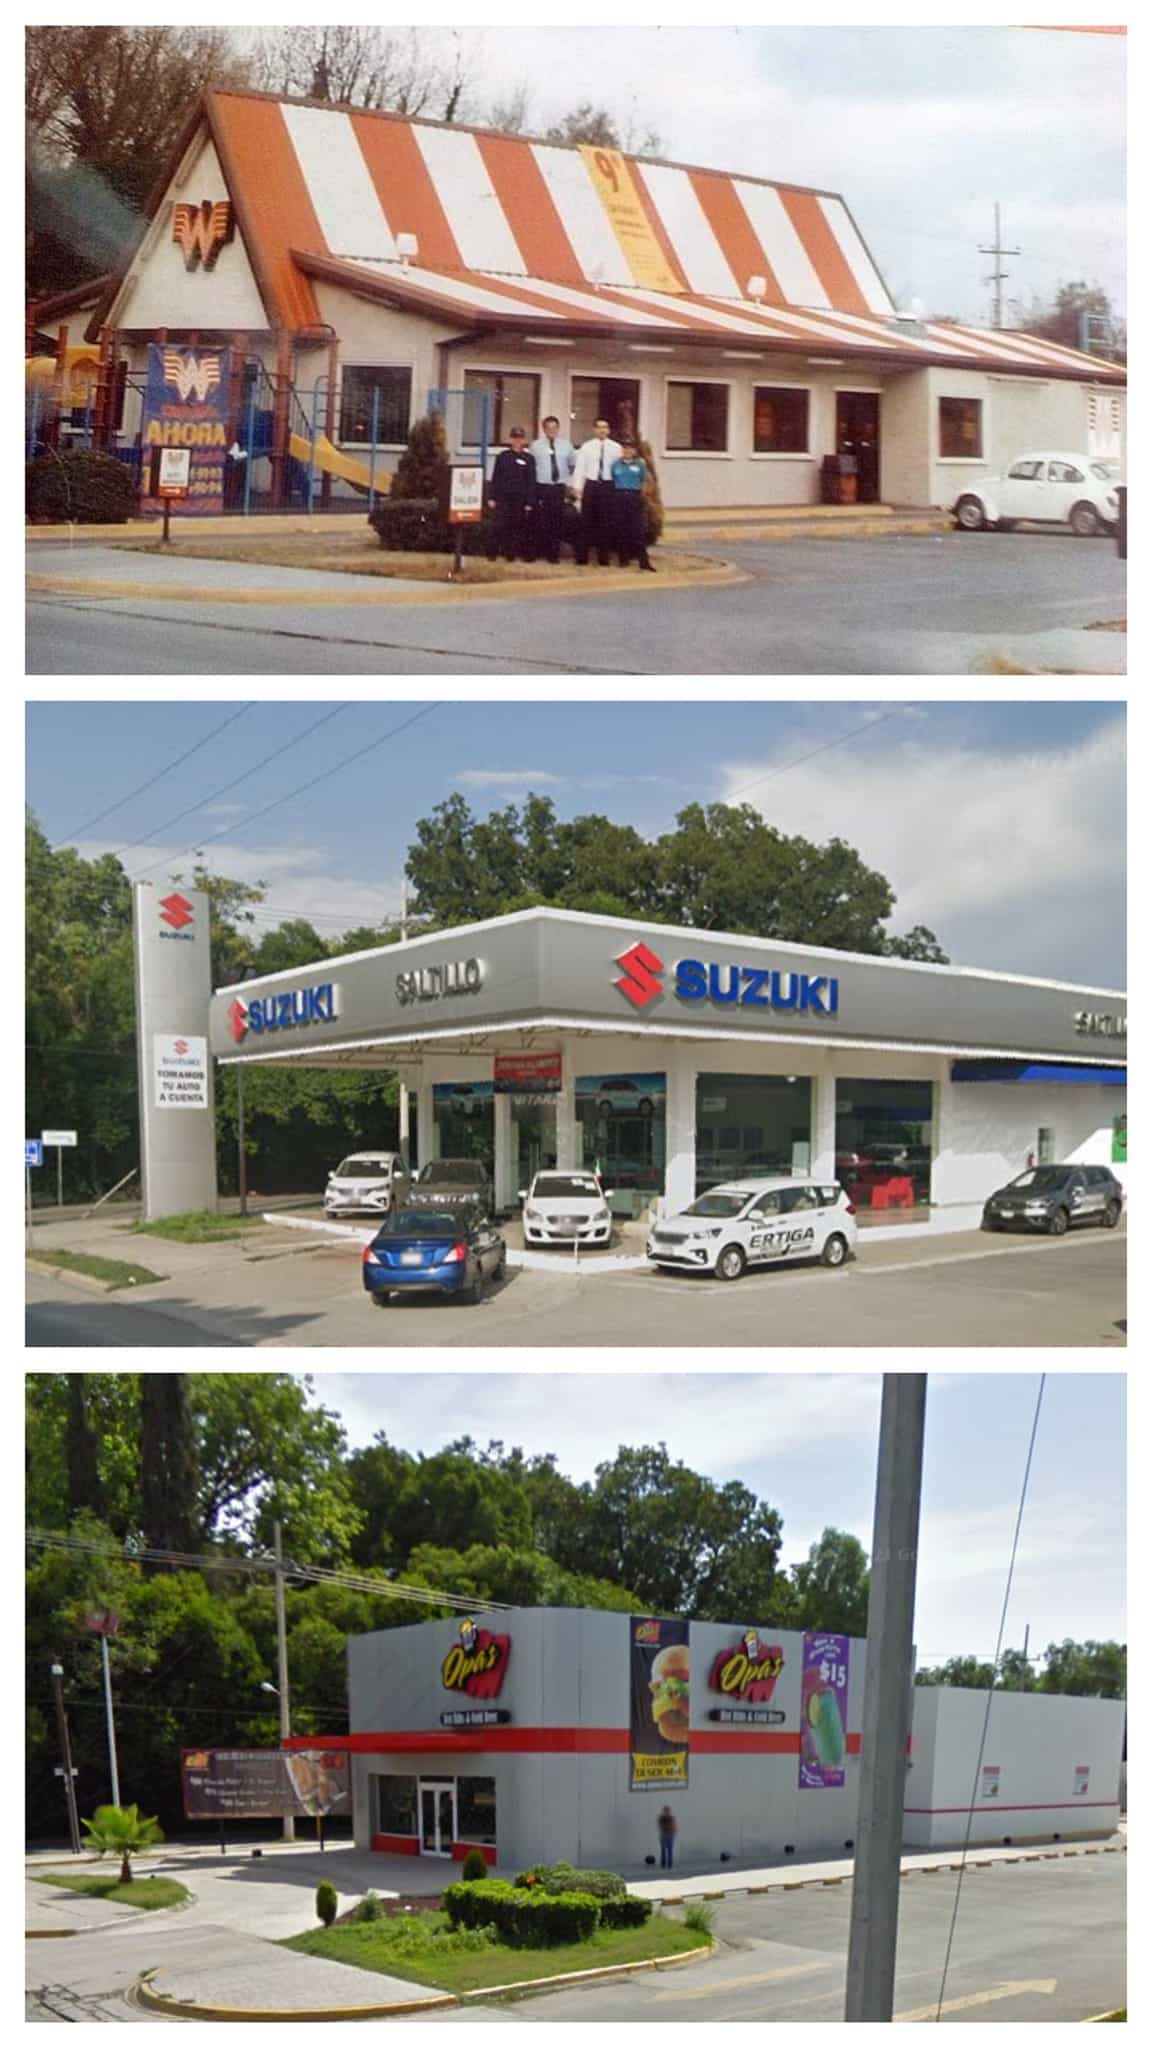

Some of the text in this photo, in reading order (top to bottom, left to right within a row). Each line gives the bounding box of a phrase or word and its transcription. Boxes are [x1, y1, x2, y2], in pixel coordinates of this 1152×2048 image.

[145, 420, 226, 446] AHORA
[396, 957, 484, 1004] SALTILLO
[674, 958, 839, 1014] SUZUKI
[248, 983, 336, 1033] SUZUKI
[157, 1070, 205, 1080] TOMAMOS
[162, 1081, 201, 1091] TU AUTO
[160, 1093, 204, 1103] A CUENTA
[750, 1227, 816, 1249] ERTIGA
[442, 1644, 498, 1690] Opa's
[720, 1654, 784, 1693] Opa's
[819, 1660, 847, 1689] $15
